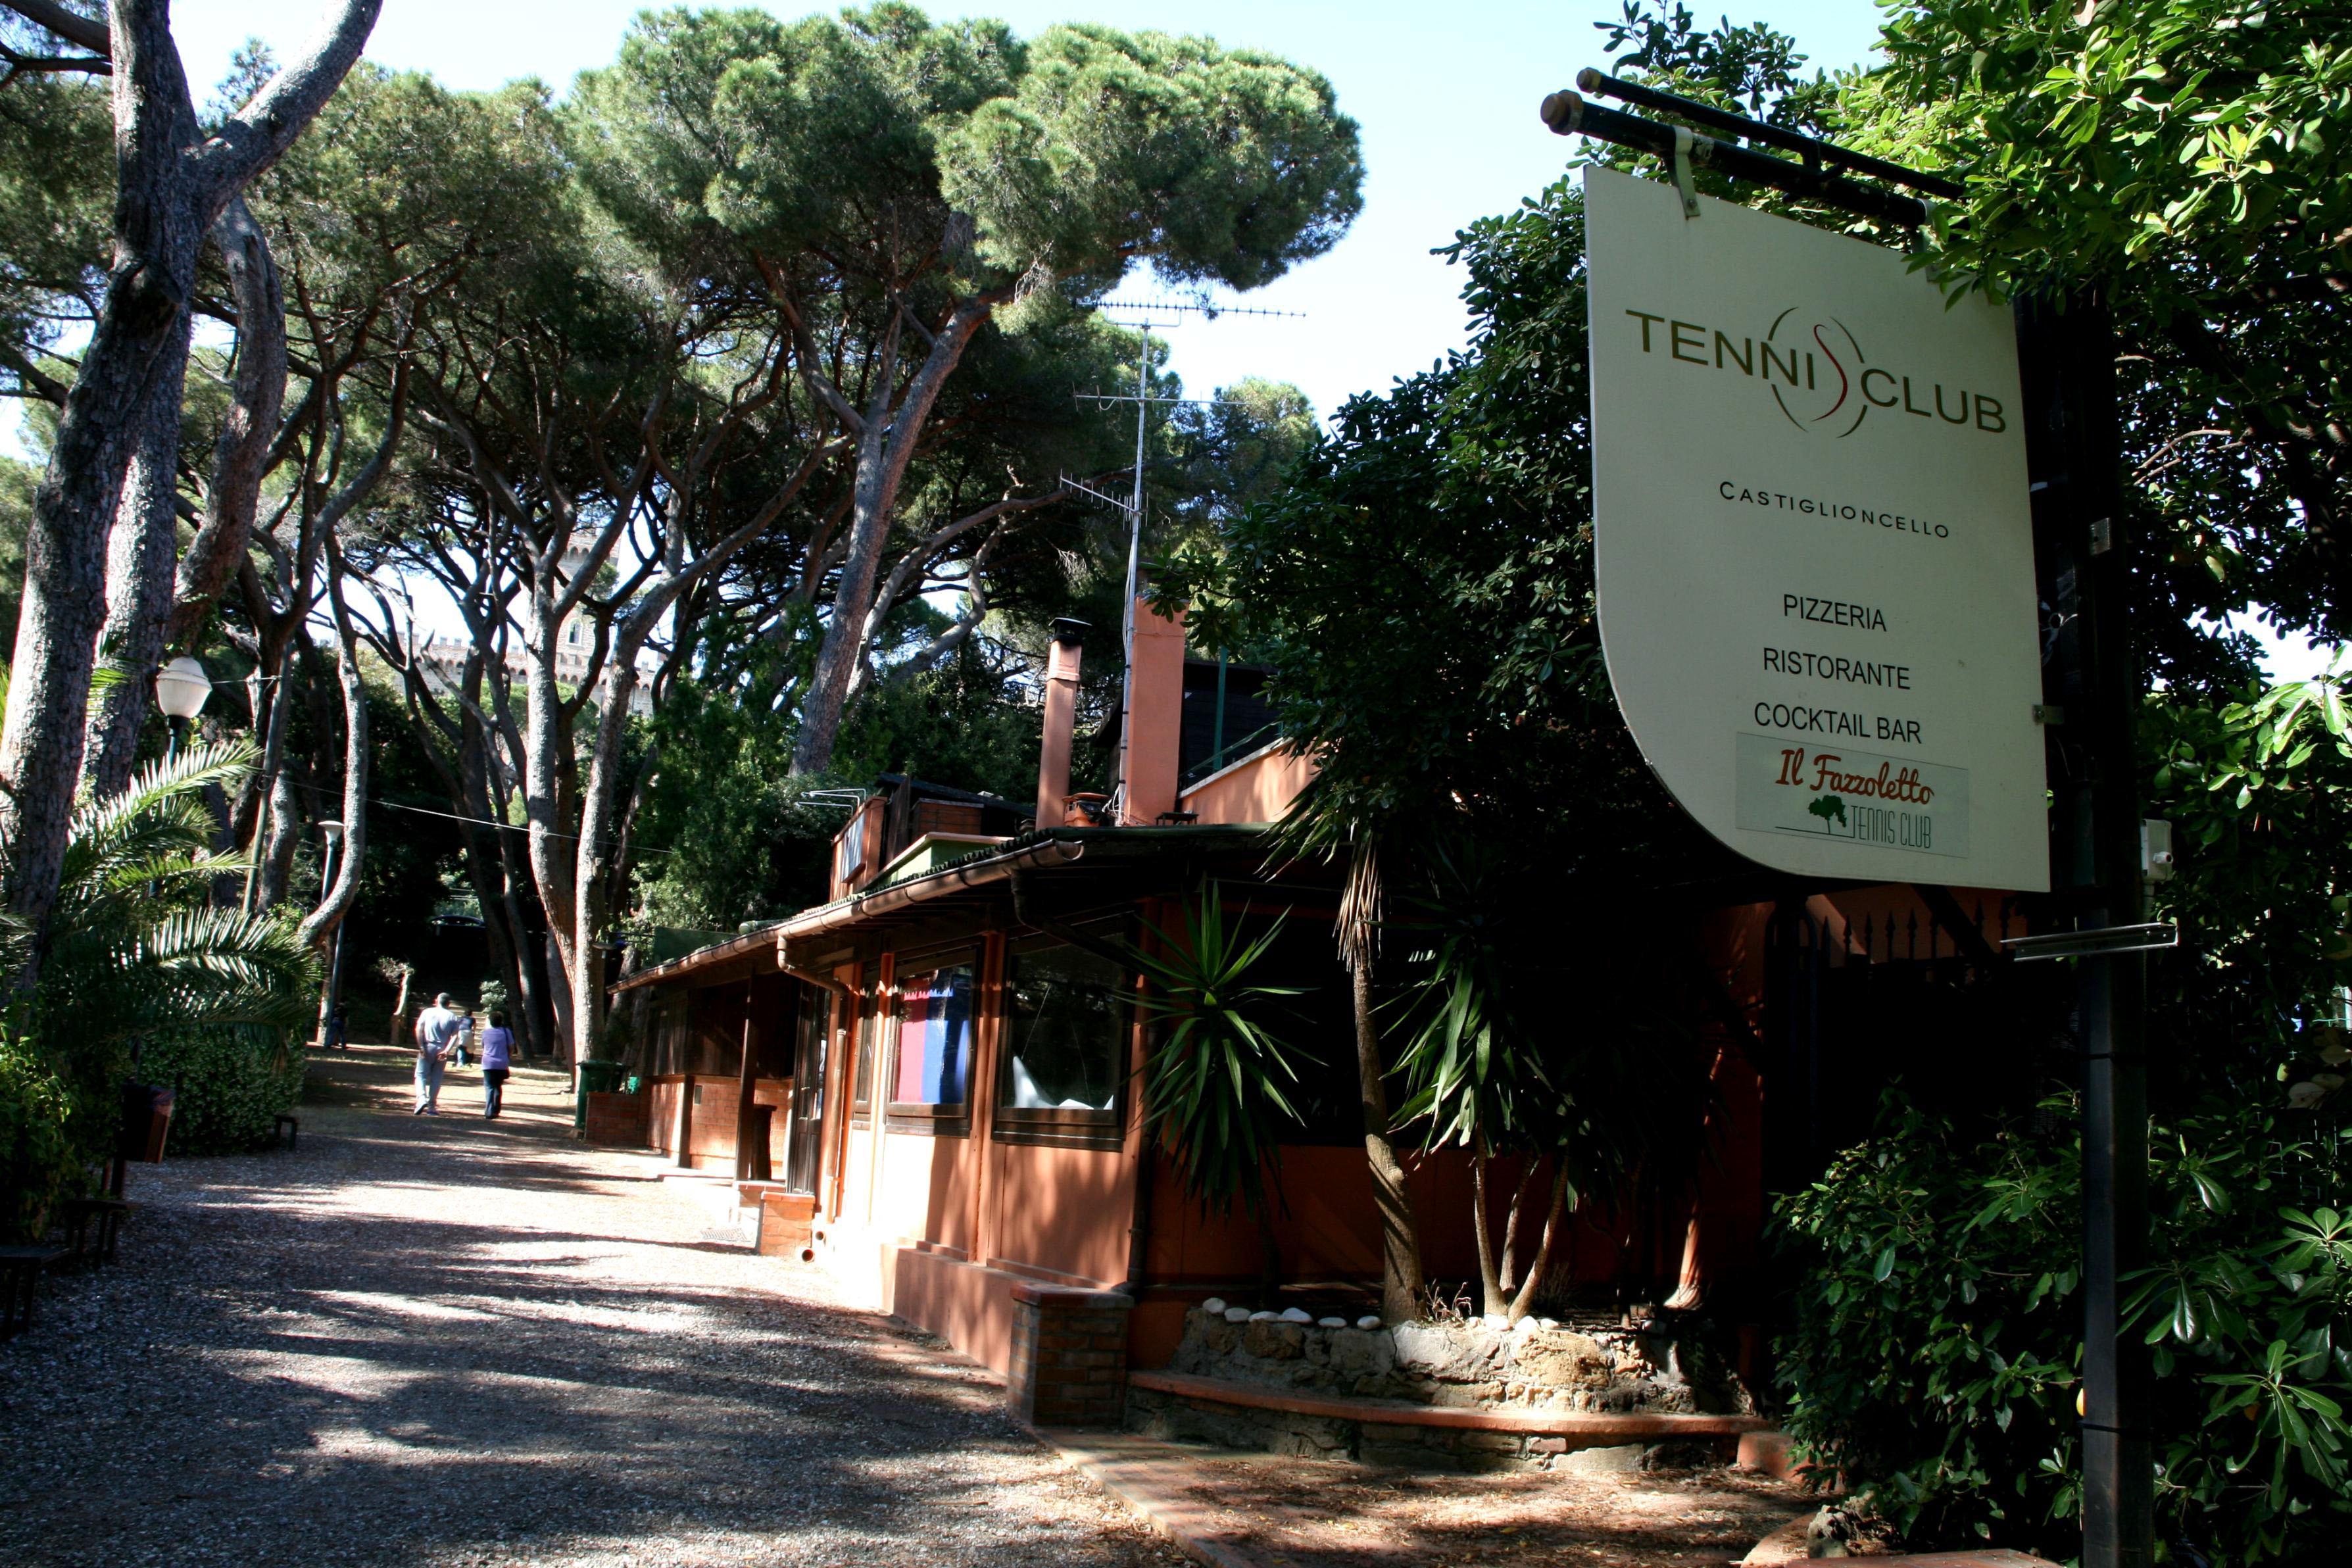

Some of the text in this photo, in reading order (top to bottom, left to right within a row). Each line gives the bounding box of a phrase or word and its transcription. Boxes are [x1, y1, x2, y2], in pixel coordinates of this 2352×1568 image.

[1625, 308, 2007, 433] TENNIS CLUB
[1719, 481, 1950, 539] CASTIGLIONCELLO
[1783, 593, 1887, 632] PIZZERIA
[1763, 647, 1911, 691] RISTORANTE
[1754, 702, 1923, 744] COCKTAIL BAR
[1775, 747, 1935, 805] Il Fazzoletto
[1850, 804, 1932, 850] TENNIS CLUB
